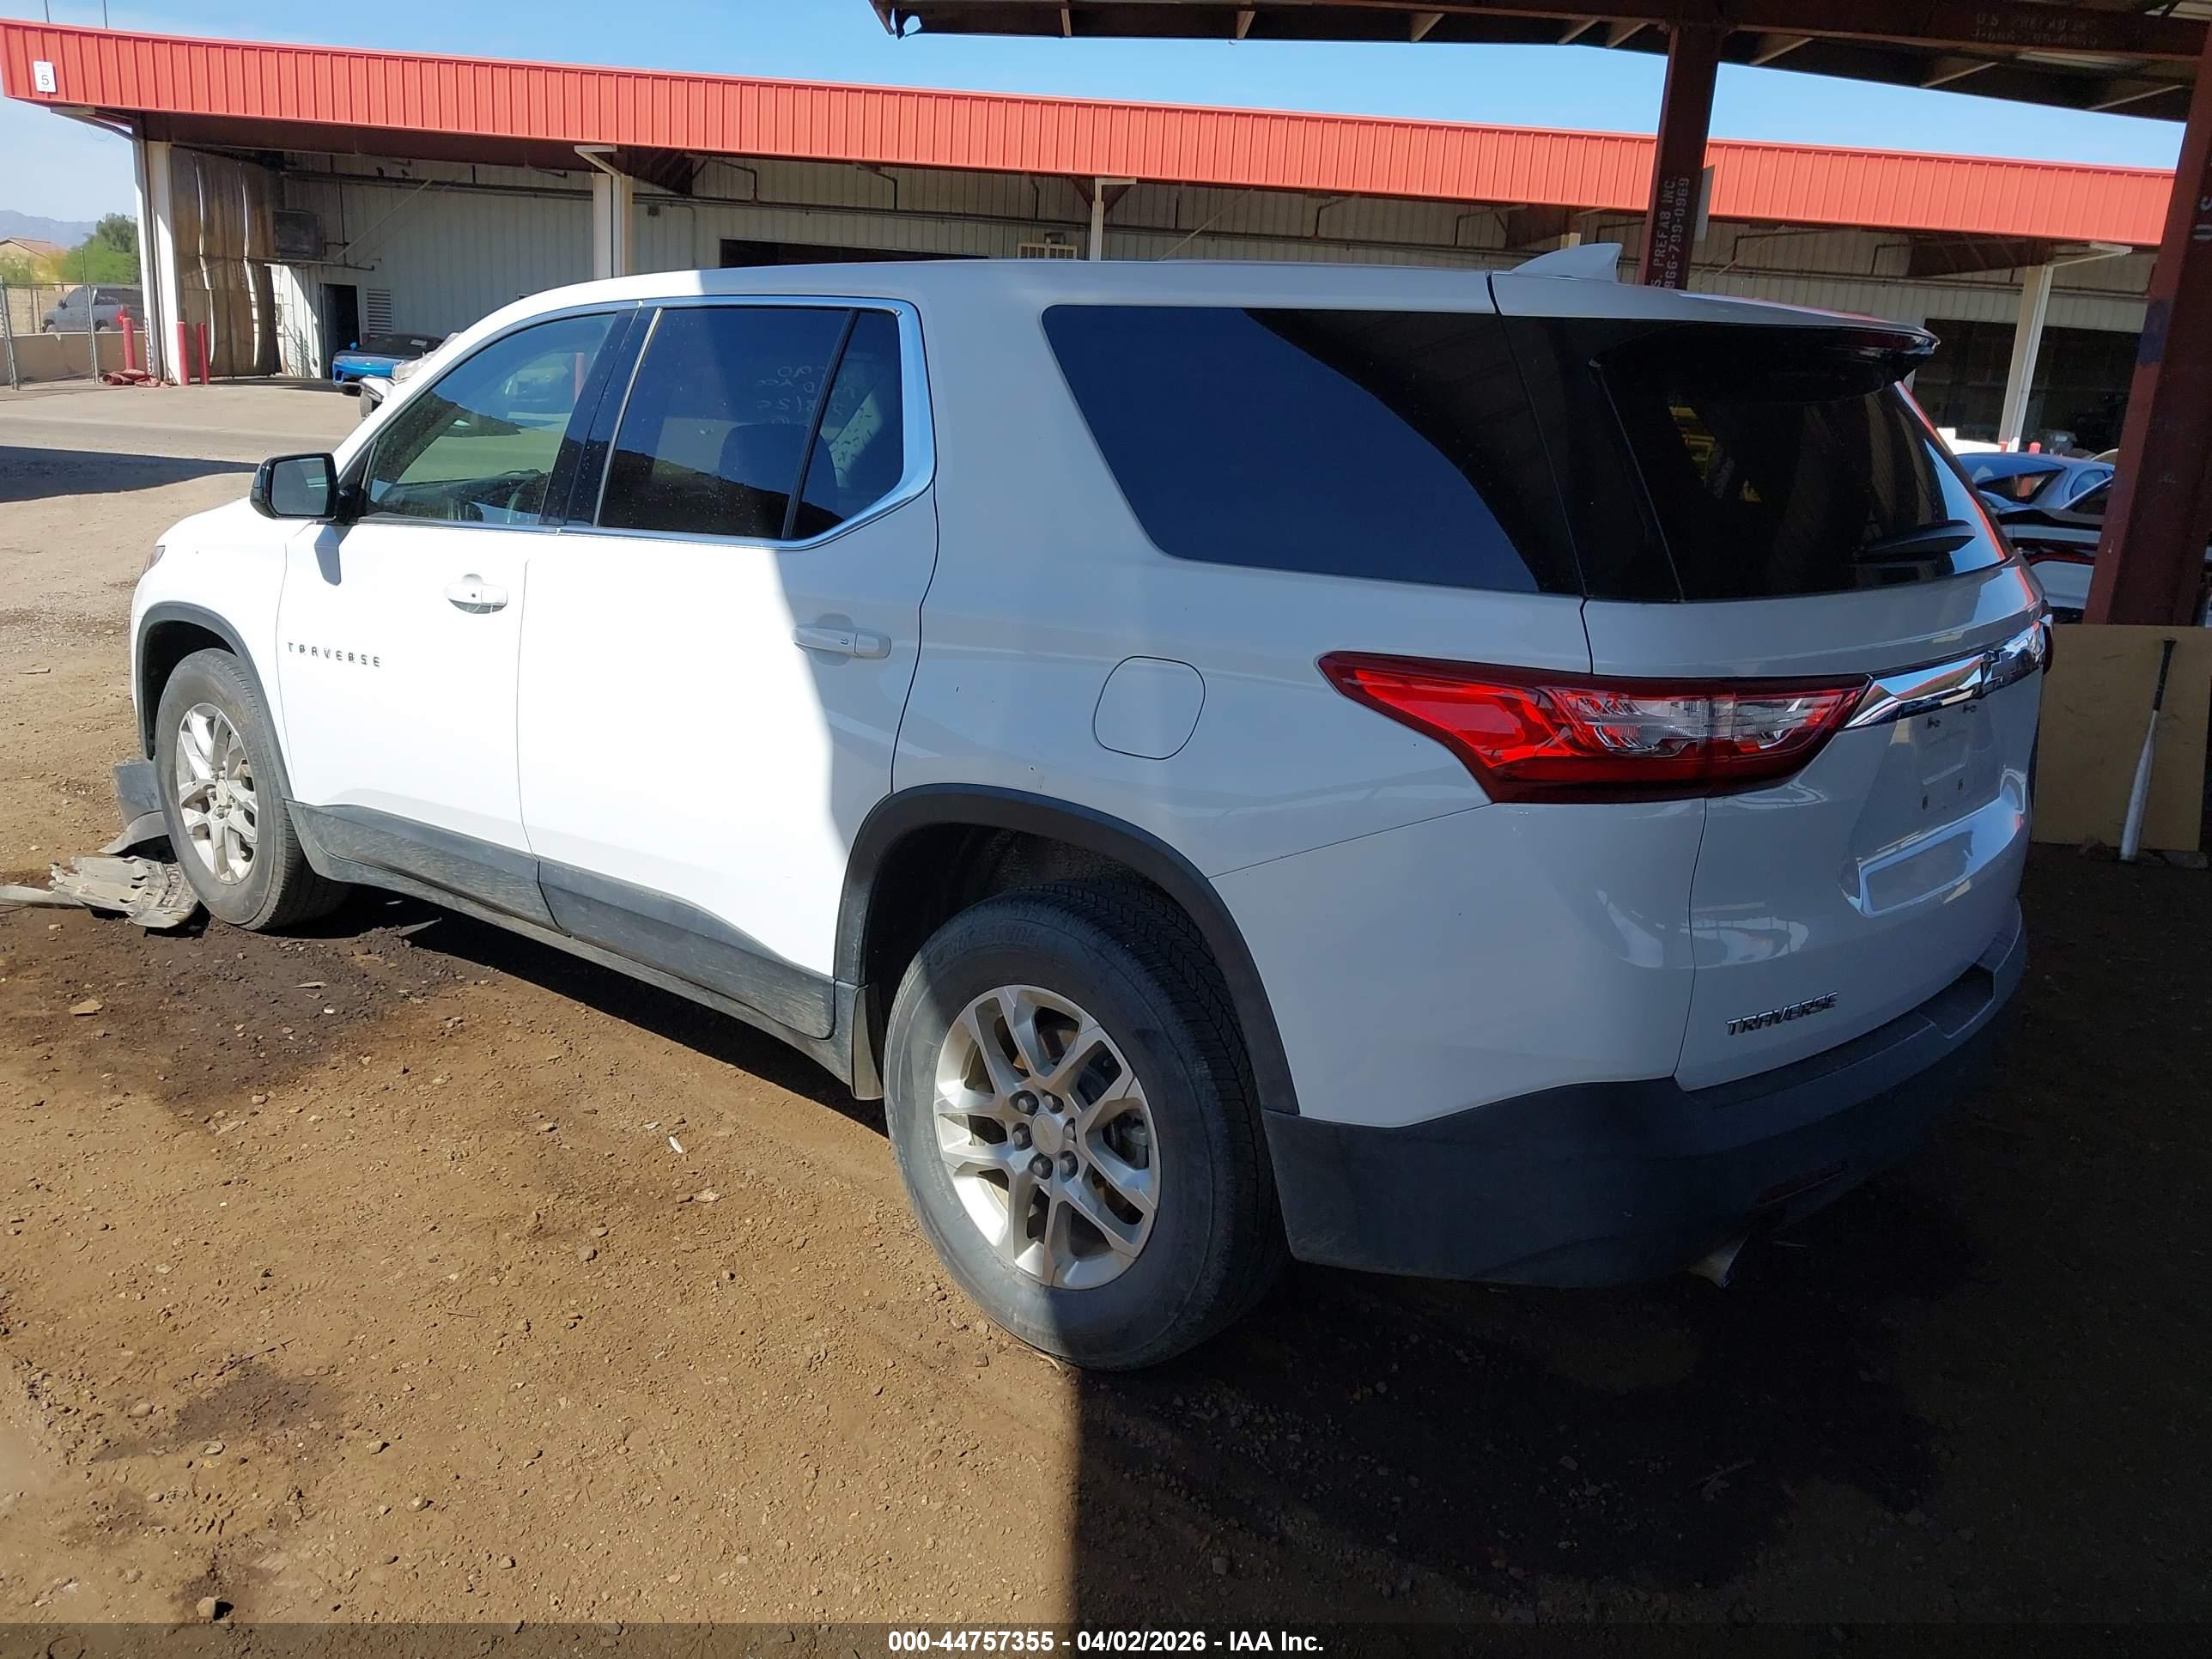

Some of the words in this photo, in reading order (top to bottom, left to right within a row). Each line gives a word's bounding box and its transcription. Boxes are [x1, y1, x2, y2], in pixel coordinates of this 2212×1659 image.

[41, 74, 50, 86] 5
[1653, 210, 1672, 267] PREFAB
[288, 641, 380, 668] TRAVERSE
[1726, 991, 1838, 1036] TRAVERSE
